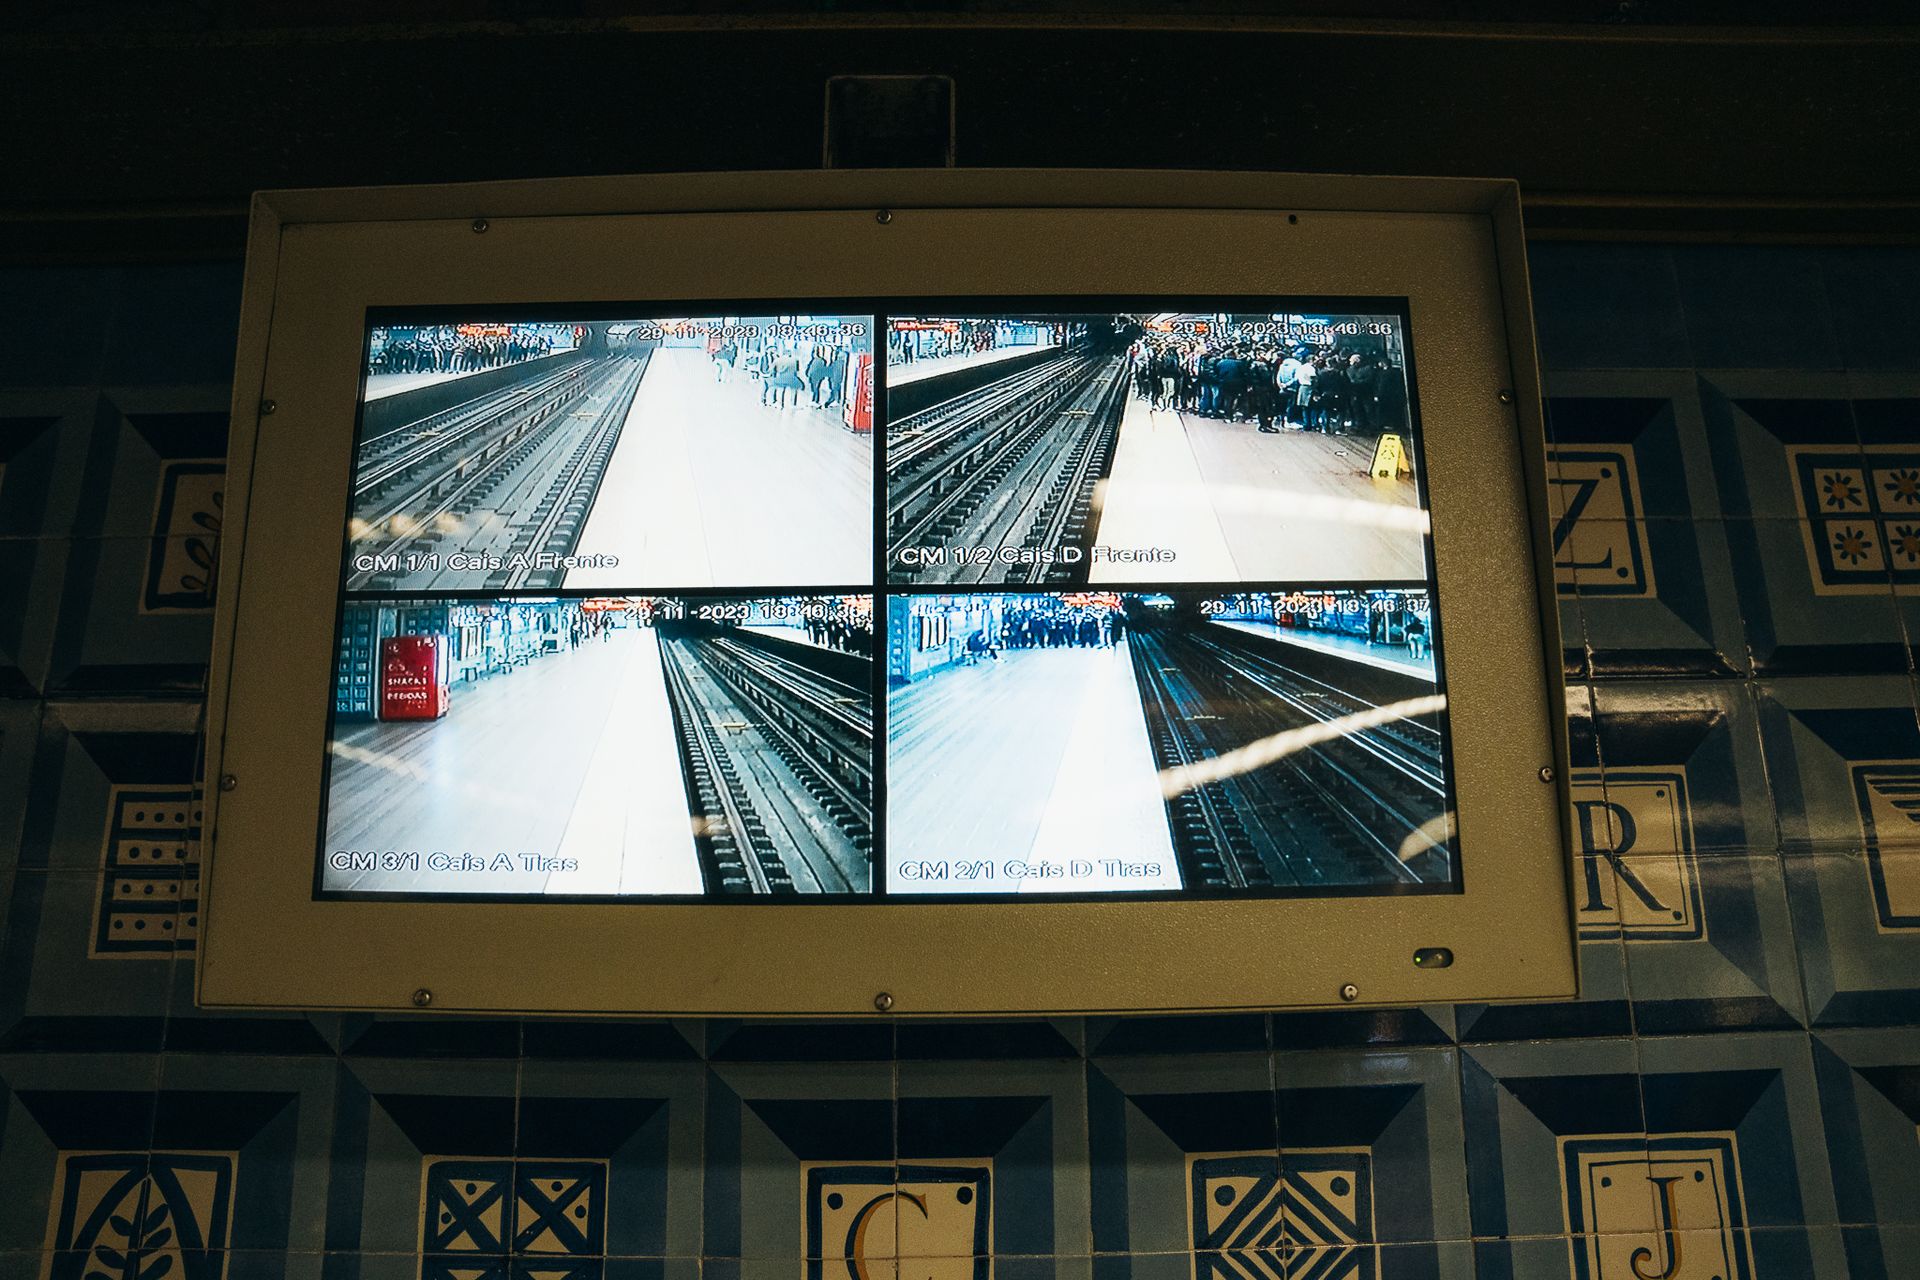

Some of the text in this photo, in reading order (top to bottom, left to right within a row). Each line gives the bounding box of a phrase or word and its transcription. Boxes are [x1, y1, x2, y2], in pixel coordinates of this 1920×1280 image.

[354, 552, 620, 571] CM 1/1 Cais A Frente
[899, 546, 1177, 564] CM 1/2 Cais D Frente
[329, 851, 580, 872] CM 3/1 Cais A Tras
[1572, 801, 1672, 912] R
[899, 858, 1162, 880] CM 2/1 Cais D Tras
[1630, 1176, 1684, 1280] J
